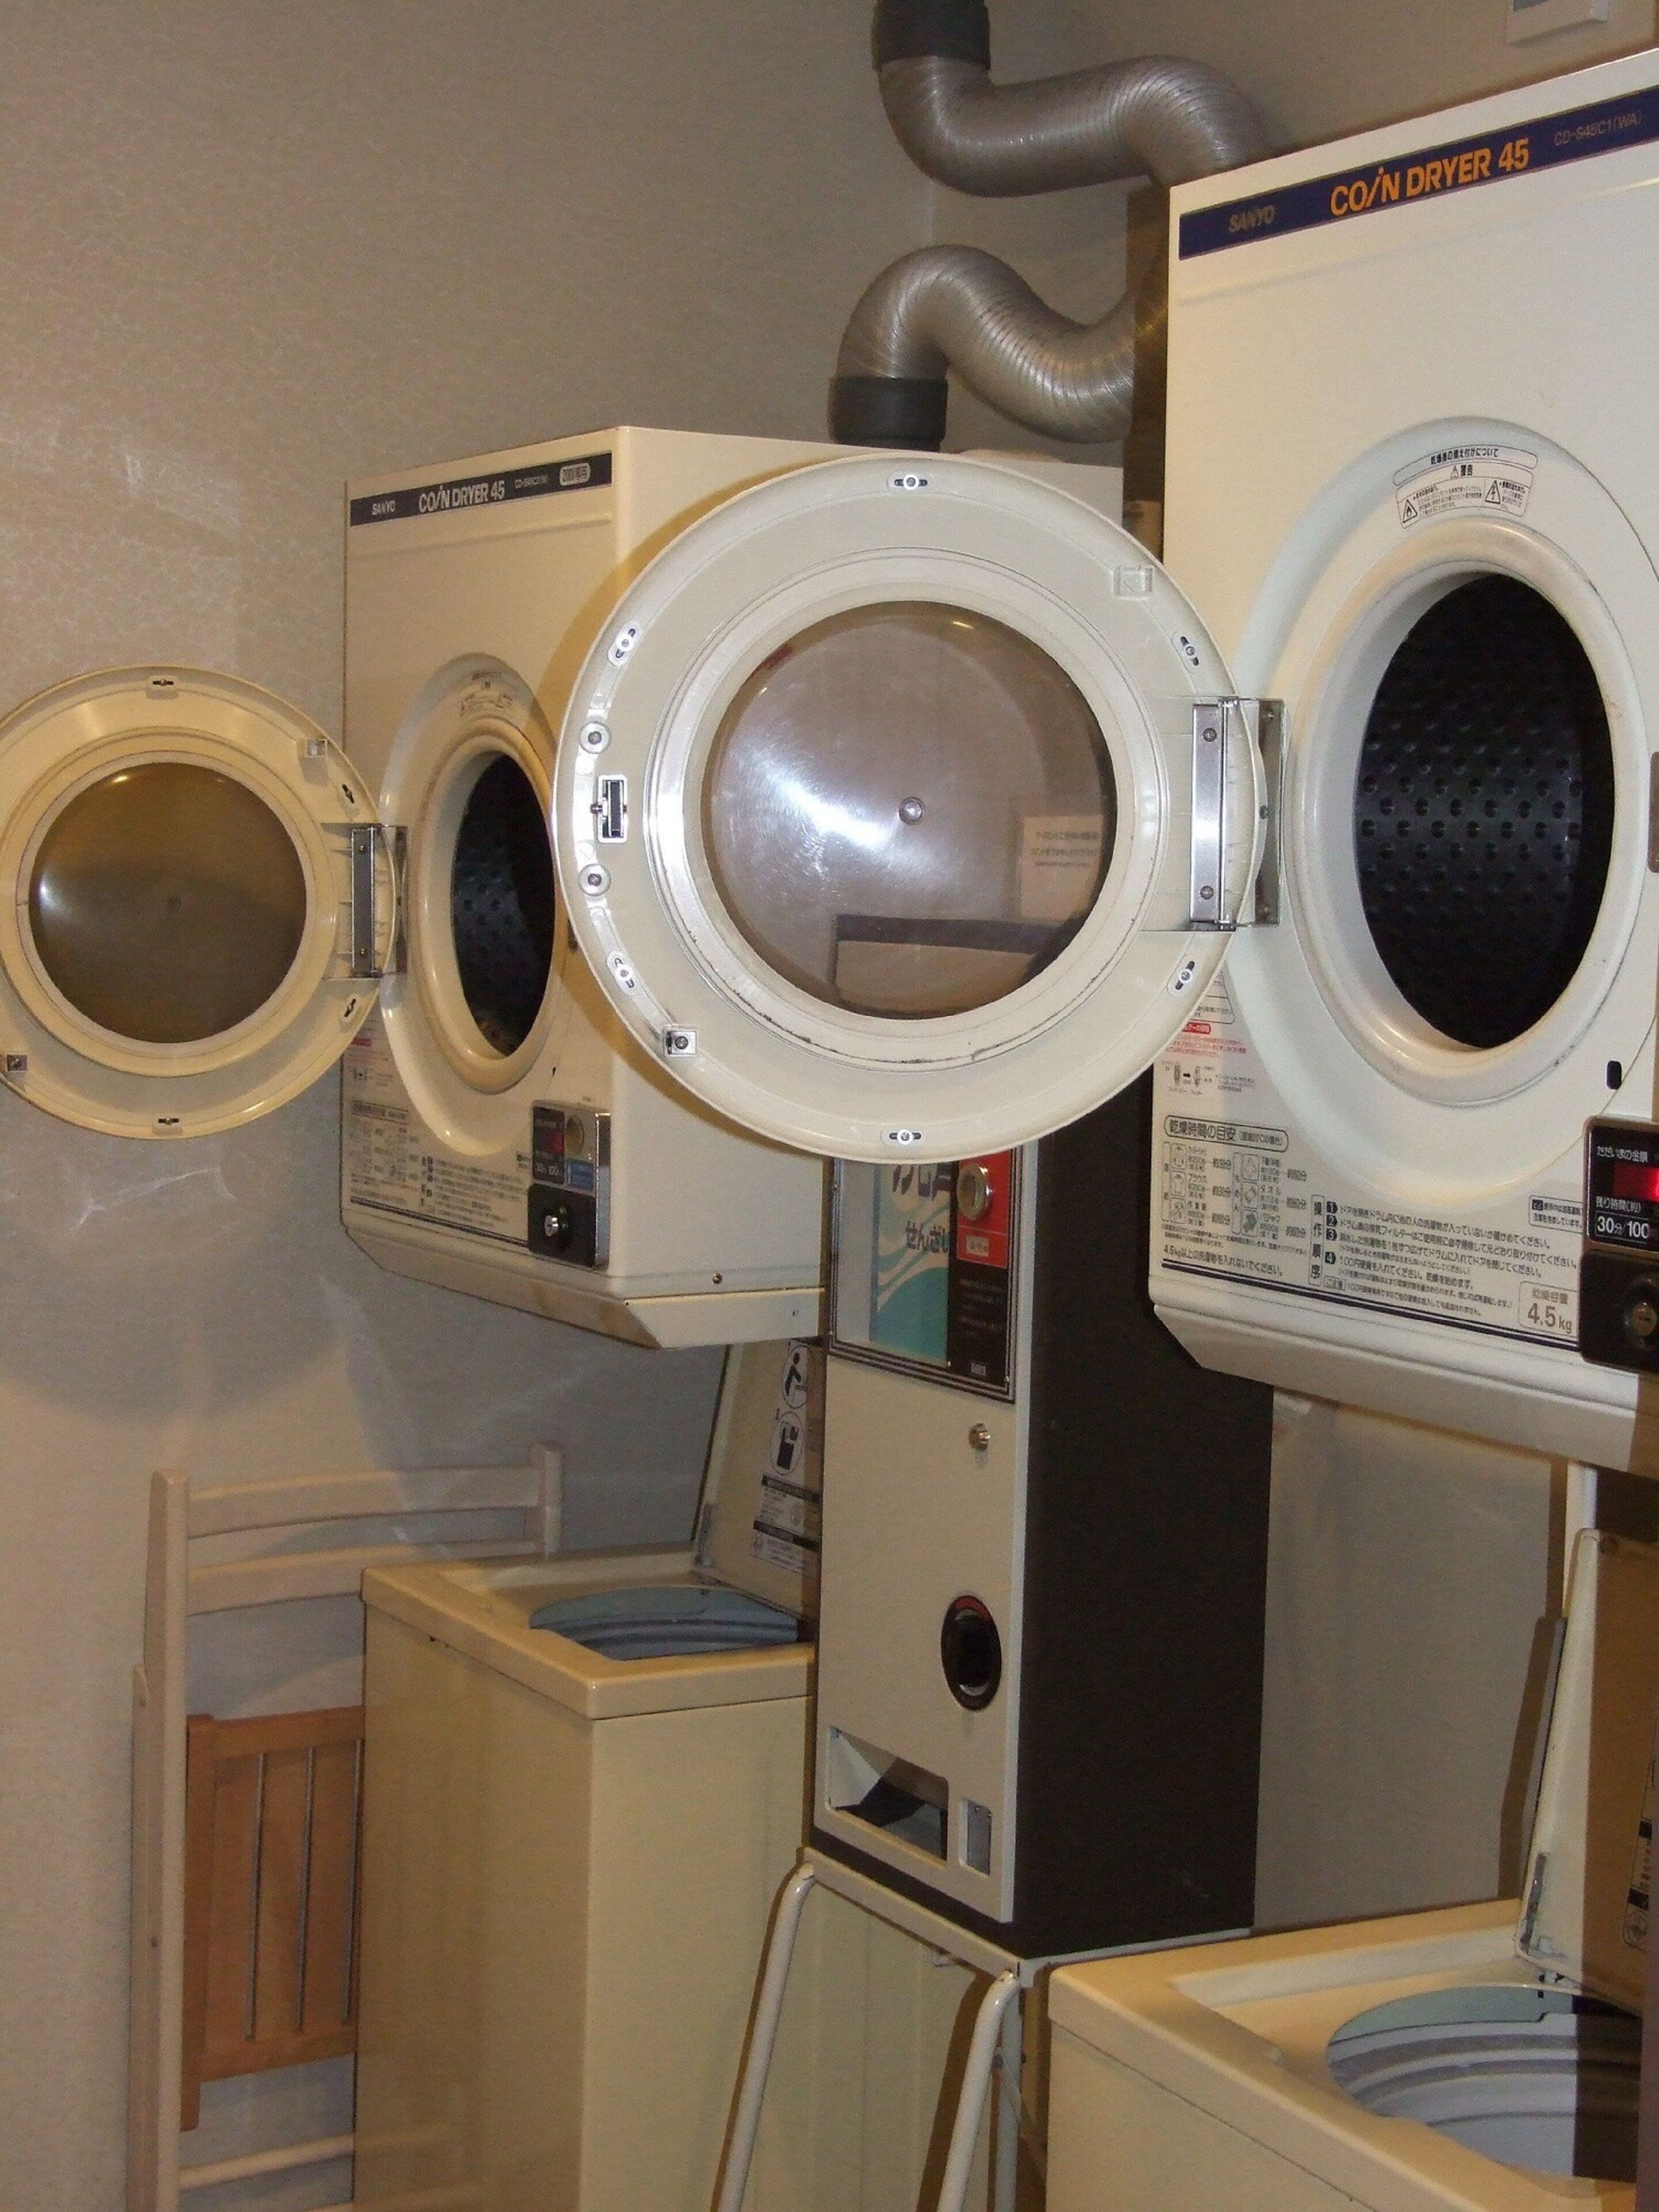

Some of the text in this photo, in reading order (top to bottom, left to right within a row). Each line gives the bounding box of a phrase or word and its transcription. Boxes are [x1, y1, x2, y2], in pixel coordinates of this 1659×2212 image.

[1228, 204, 1275, 233] SANYO
[1330, 166, 1399, 217] COIN
[1405, 147, 1491, 196] DRYER
[1498, 138, 1530, 172] 45
[372, 500, 396, 516] SANYO
[418, 484, 450, 513] COIN
[452, 484, 488, 507] DRYER
[490, 480, 505, 501] 45
[1169, 1119, 1237, 1142] 乾燥時間の目安
